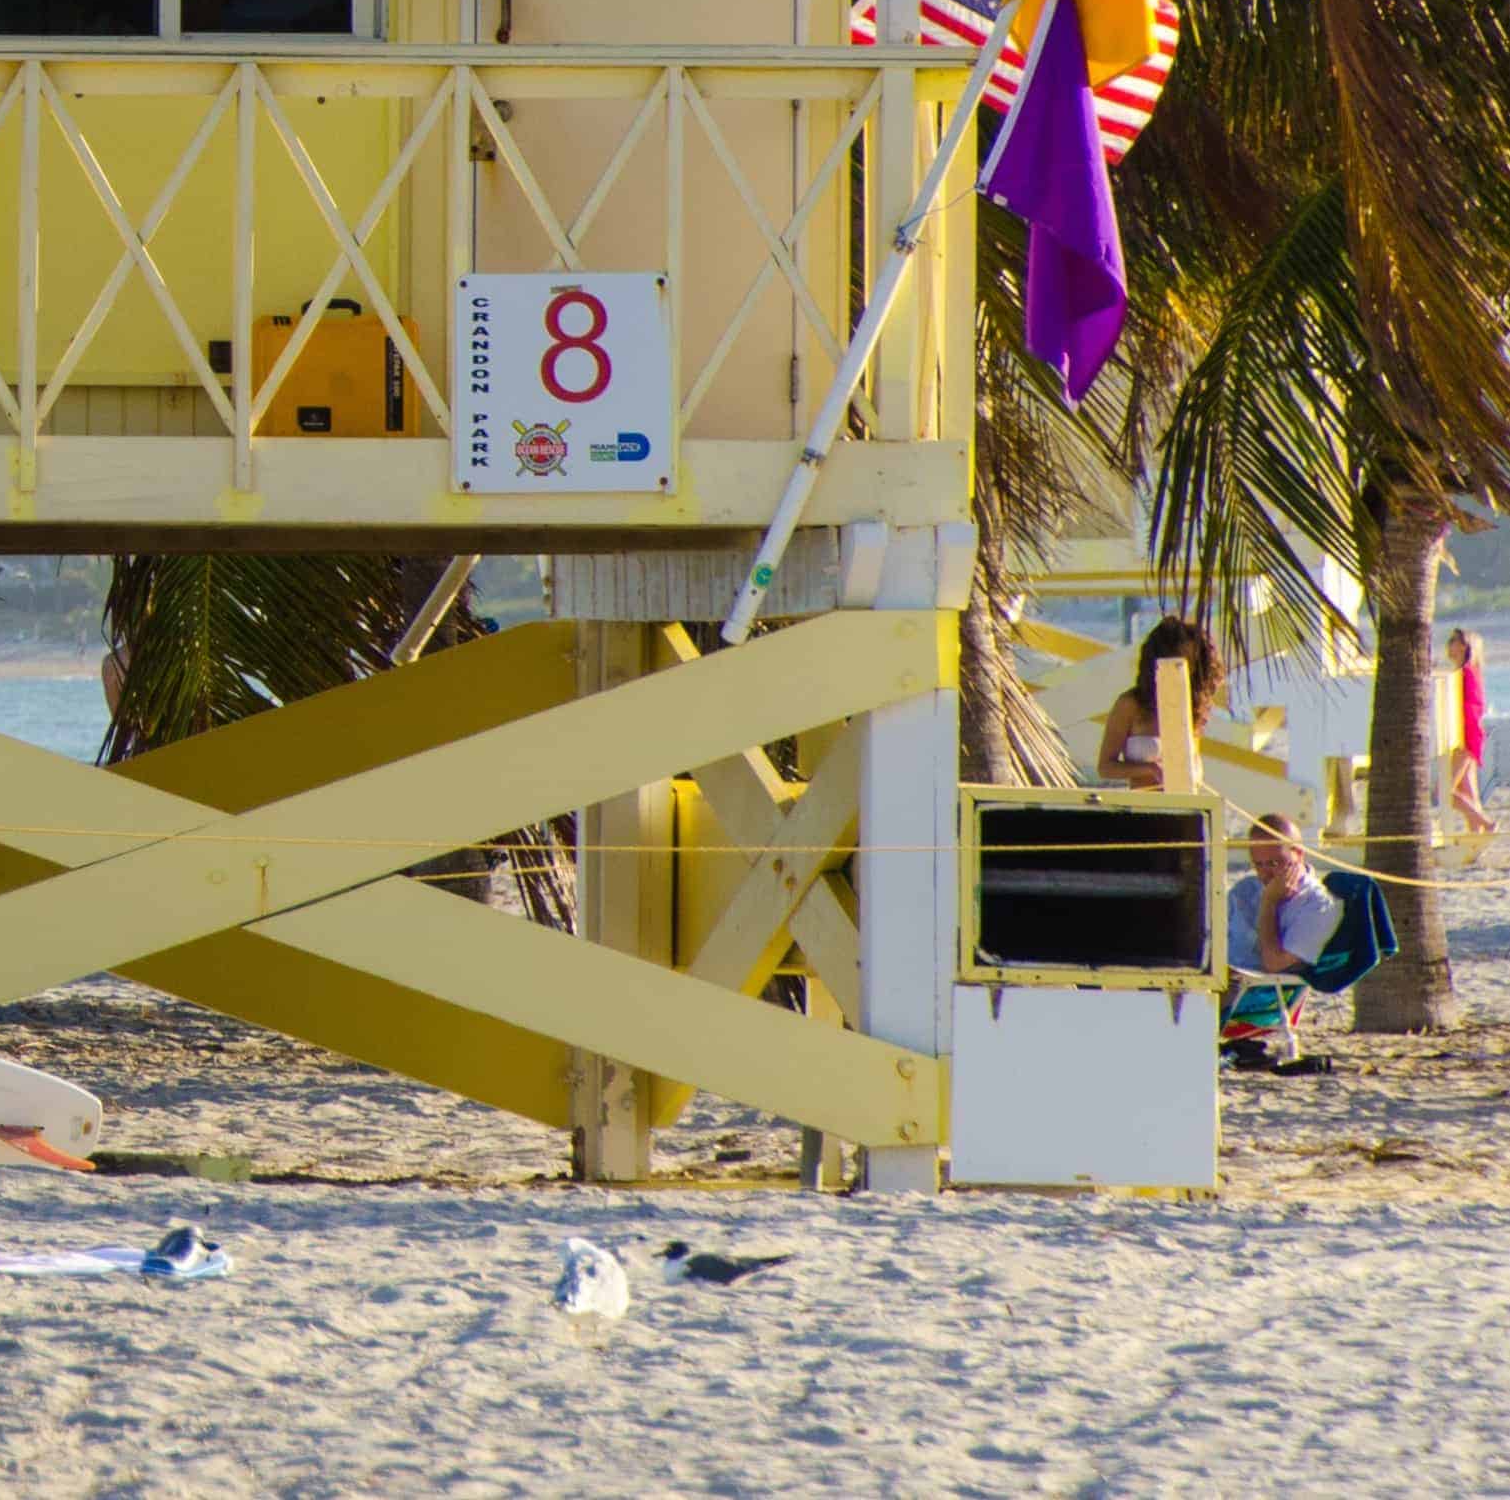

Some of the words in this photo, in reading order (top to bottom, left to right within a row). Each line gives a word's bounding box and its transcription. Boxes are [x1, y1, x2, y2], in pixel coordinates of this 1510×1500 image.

[471, 298, 490, 393] CRANDON
[541, 291, 613, 404] 8
[471, 414, 489, 467] PARK
